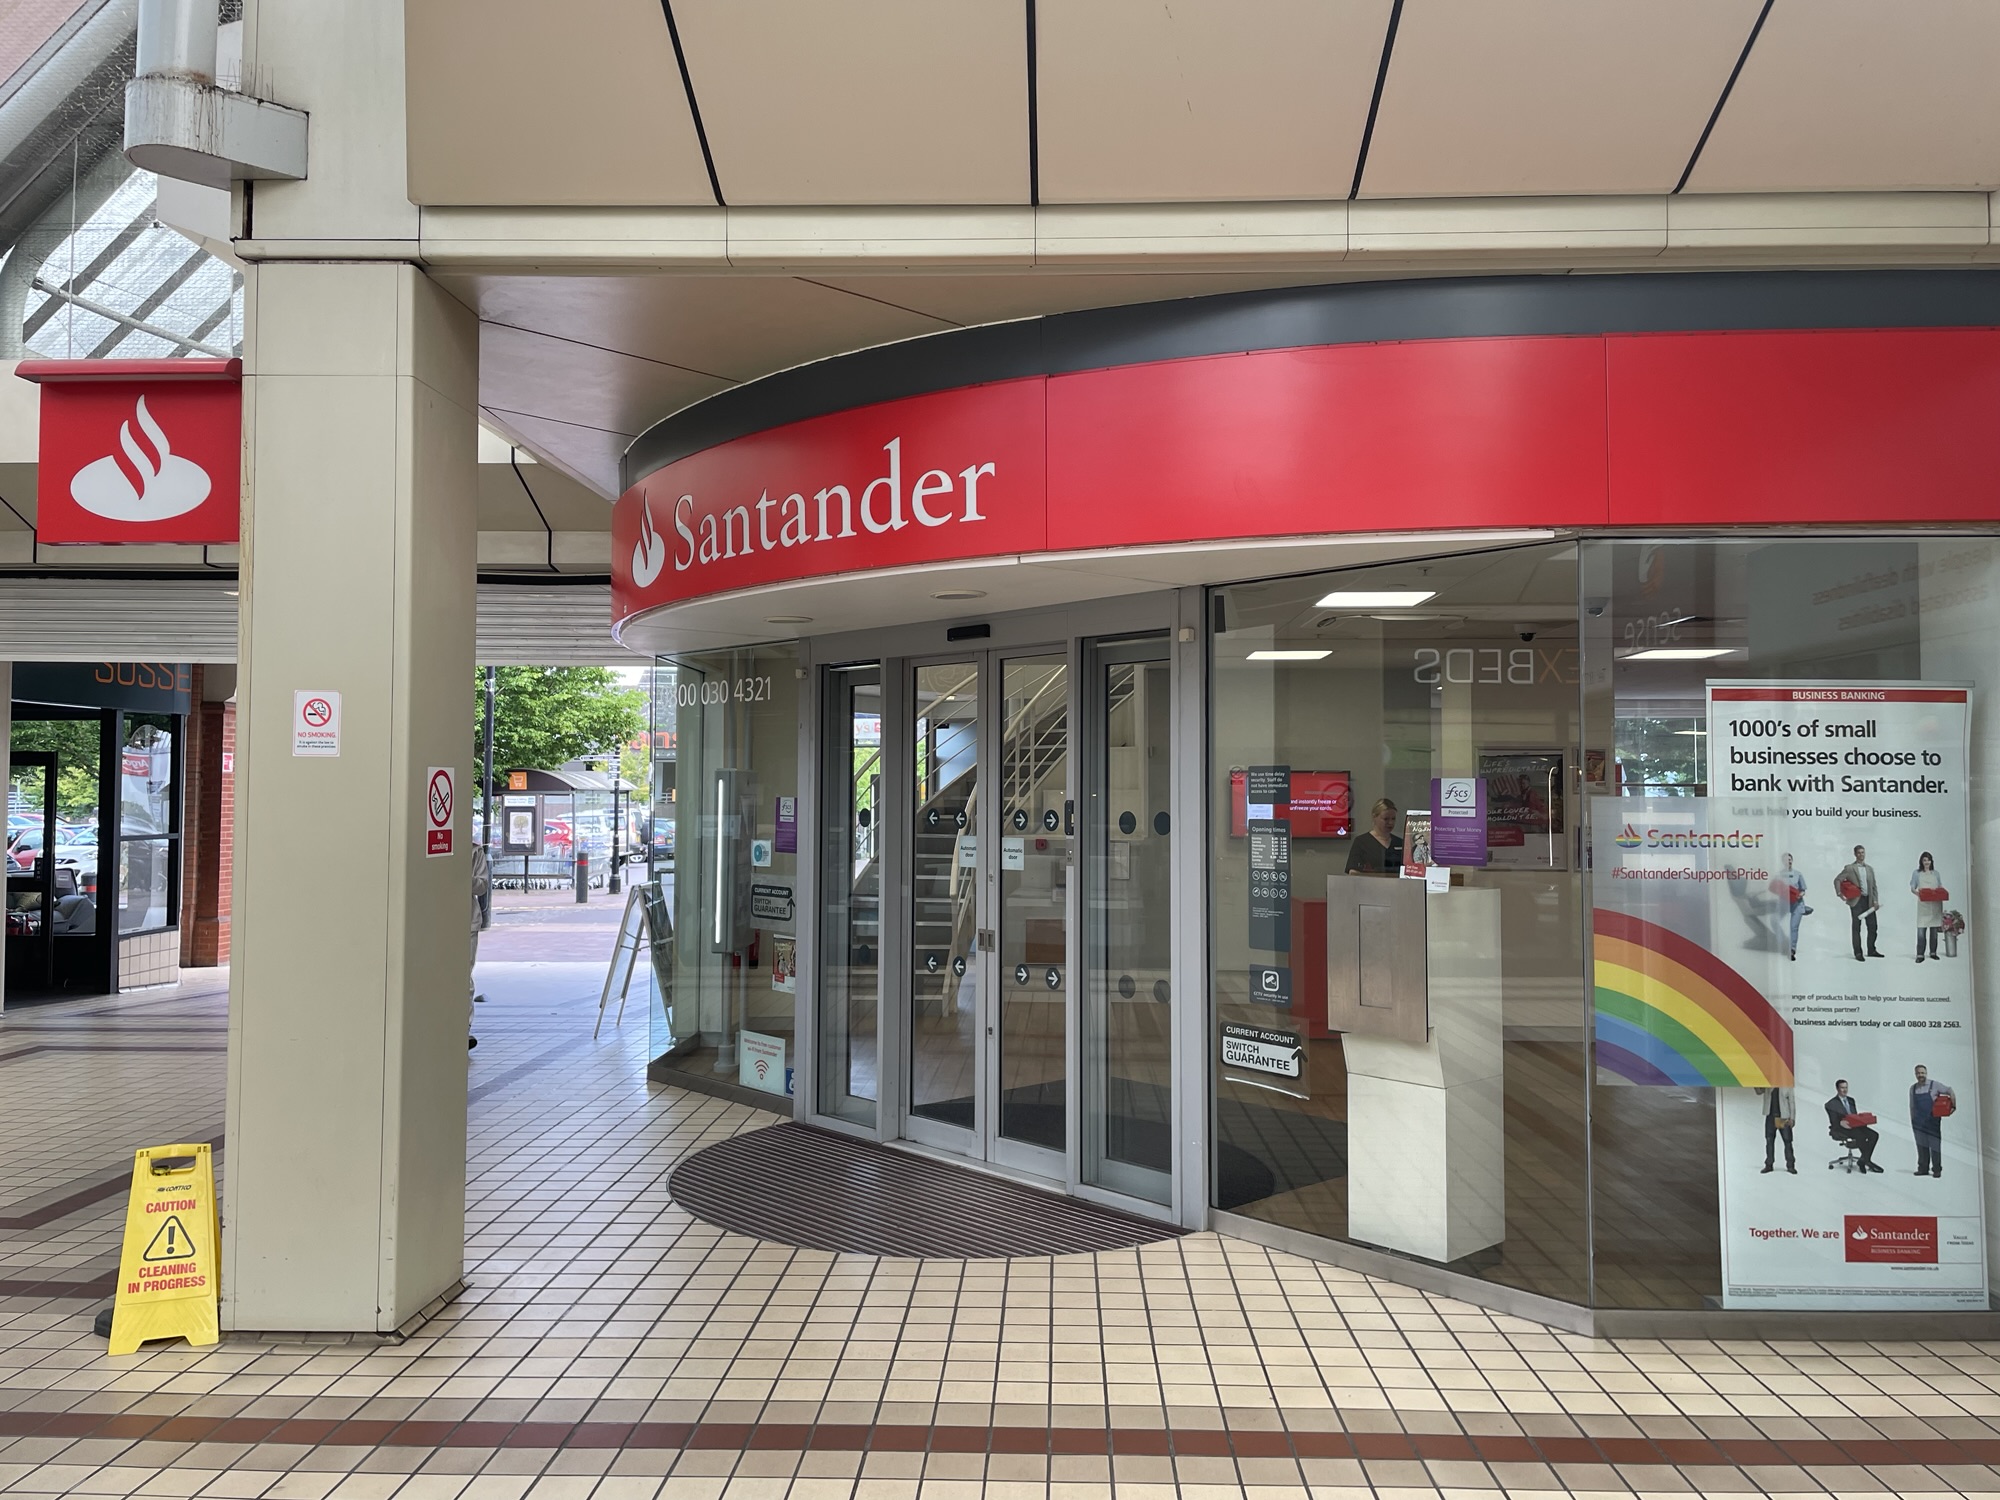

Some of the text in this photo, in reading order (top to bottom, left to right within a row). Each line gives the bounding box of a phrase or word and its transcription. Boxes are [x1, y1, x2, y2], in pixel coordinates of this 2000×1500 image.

[673, 435, 996, 572] Santander
[701, 679, 729, 705] 030
[733, 676, 771, 702] 4321
[1792, 691, 1886, 700] BUSINESS BANKING
[1728, 719, 1877, 738] 1000's of small
[1730, 746, 1942, 766] businesses choose to
[1731, 773, 1948, 794] bank with Santander.
[1752, 808, 1764, 816] us
[1792, 808, 1812, 818] you
[1815, 806, 1842, 817] build
[1845, 808, 1869, 819] your
[1872, 807, 1922, 818] business.
[432, 842, 448, 851] smoking
[1647, 829, 1764, 848] Santander
[1611, 867, 1768, 883] #SantanderSupportsPride
[754, 905, 786, 914] GUARANTEE
[1794, 1018, 1826, 1026] business
[1860, 1019, 1881, 1028] today
[1226, 1025, 1294, 1044] CURRENT ACCOUNT
[1226, 1040, 1259, 1054] SWITCH
[1226, 1050, 1290, 1071] GUARANTEE
[146, 1199, 196, 1214] CAUTION
[1749, 1227, 1839, 1240] Together. We are
[1870, 1228, 1930, 1240] Santander
[138, 1262, 196, 1278] CLEANING
[128, 1276, 206, 1293] IN PROGRESS
